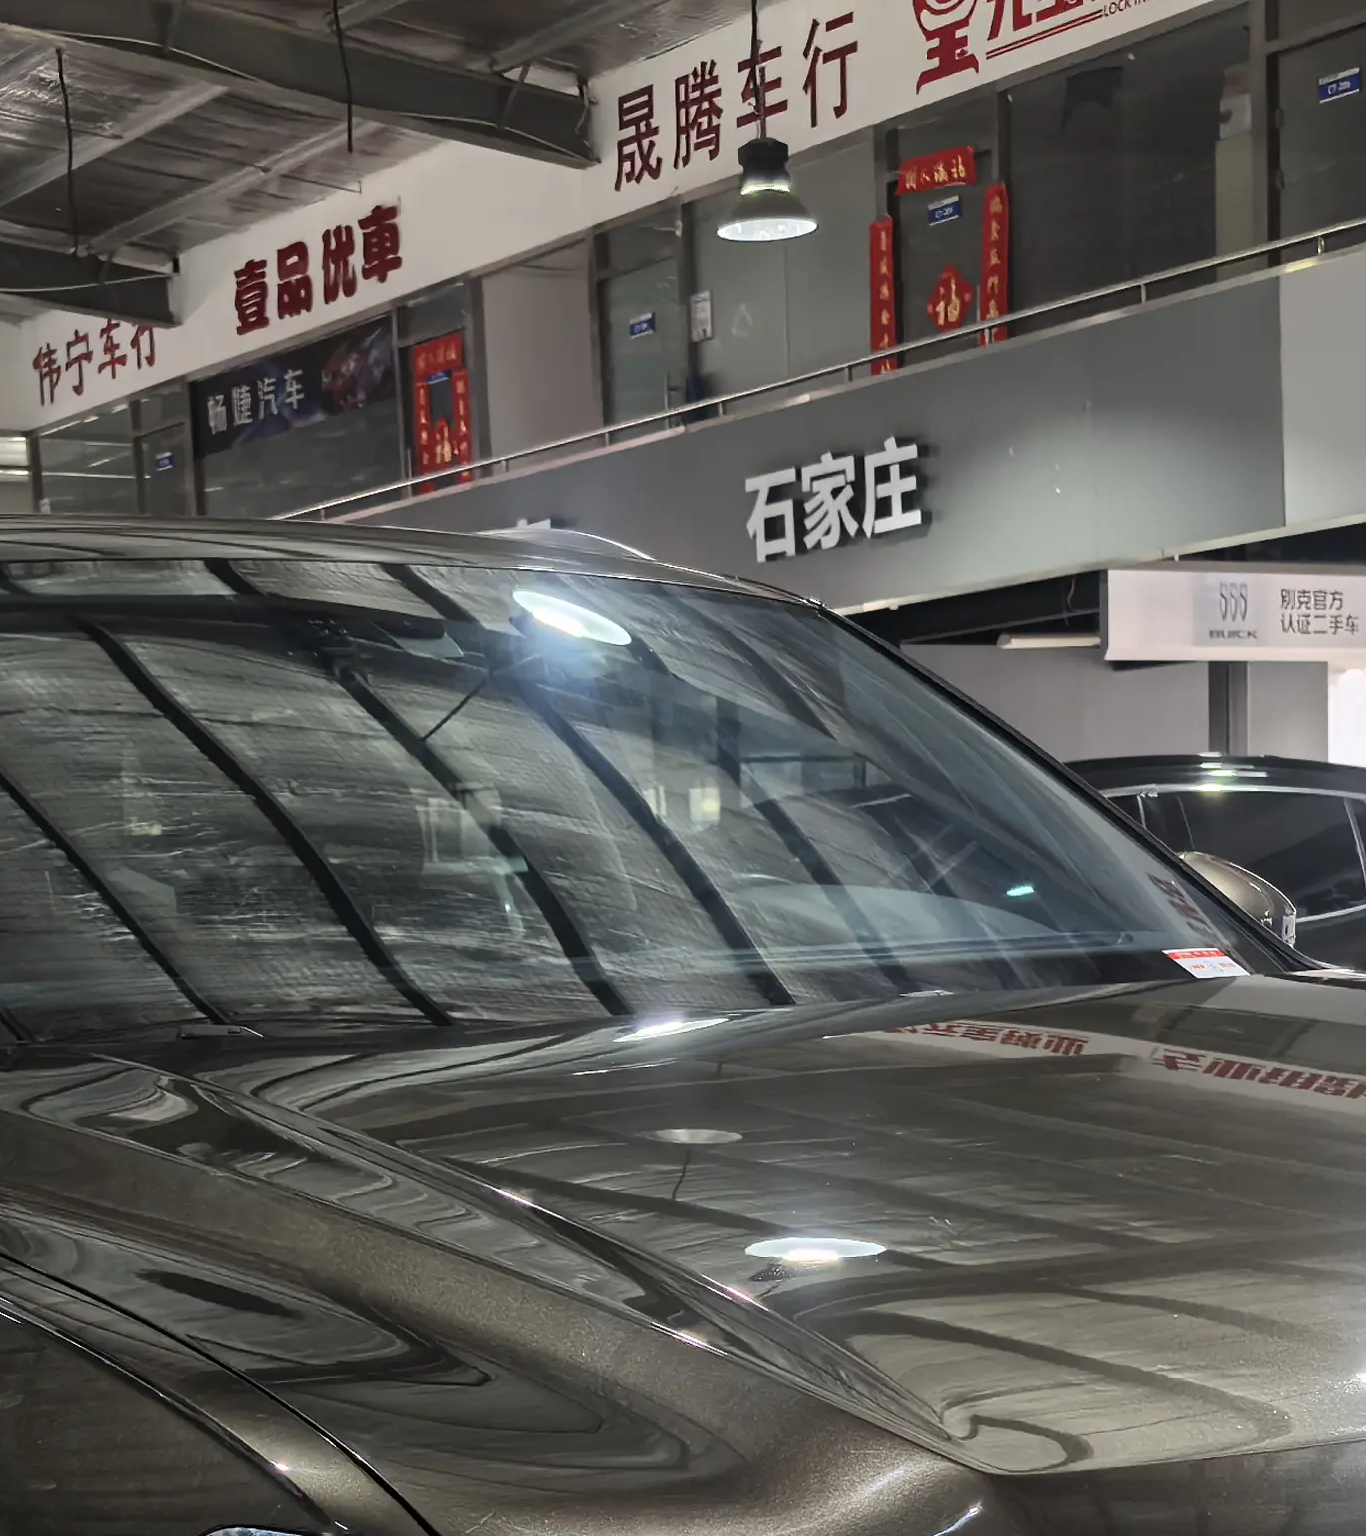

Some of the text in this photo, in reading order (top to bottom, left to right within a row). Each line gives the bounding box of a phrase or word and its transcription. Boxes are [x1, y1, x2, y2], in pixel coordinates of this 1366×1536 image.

[614, 12, 860, 191] 晟腾车行
[744, 436, 923, 563] 石家庄
[1280, 588, 1344, 611] 别克官方
[1208, 629, 1259, 640] BUICK
[1280, 614, 1360, 636] 认证二手车
